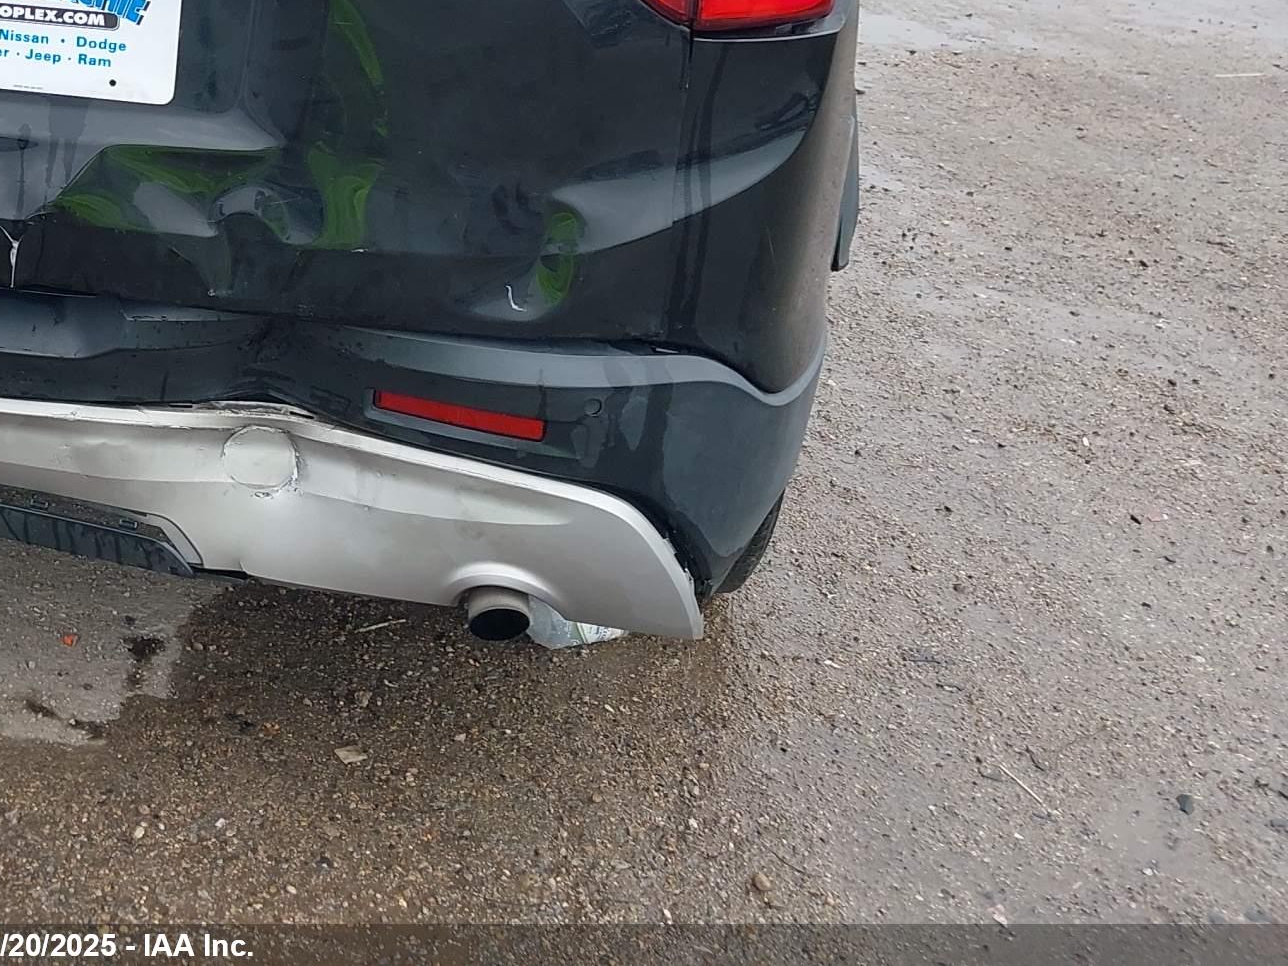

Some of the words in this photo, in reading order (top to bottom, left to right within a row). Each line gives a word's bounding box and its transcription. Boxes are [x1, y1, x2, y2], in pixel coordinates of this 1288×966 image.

[76, 36, 127, 53] Dodge
[25, 48, 62, 64] Jeep
[77, 53, 112, 68] Ram
